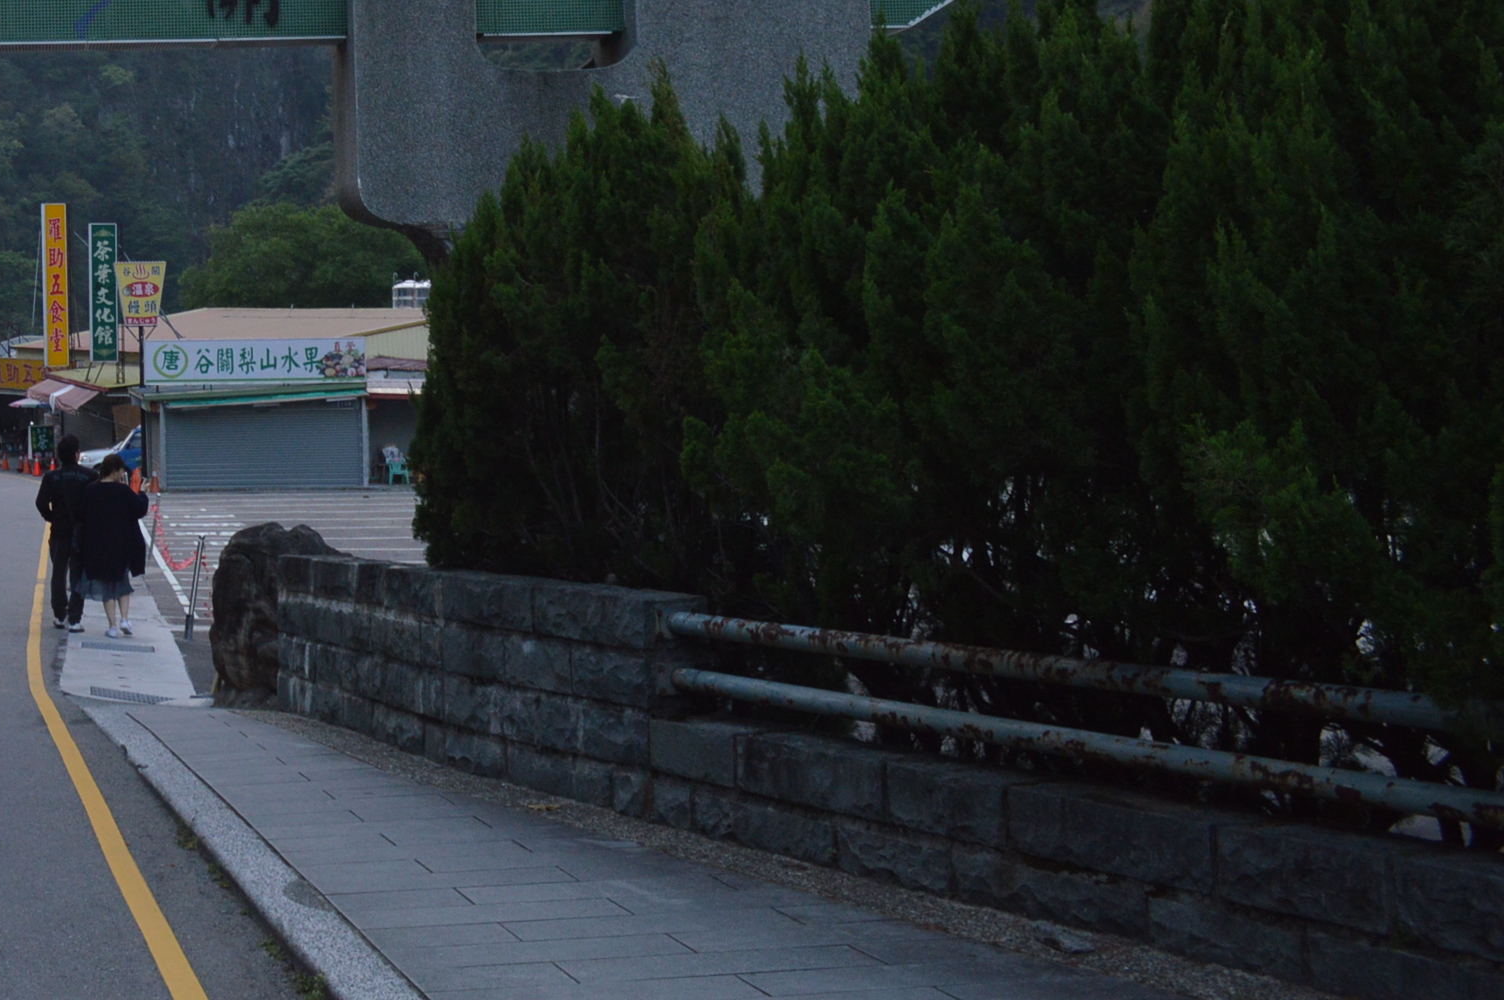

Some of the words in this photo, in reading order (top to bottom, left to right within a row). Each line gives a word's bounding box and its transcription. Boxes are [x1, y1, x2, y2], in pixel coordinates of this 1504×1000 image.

[93, 240, 115, 345] 茶葉文化館
[128, 300, 157, 314] 饅頭
[161, 350, 179, 371] 唐
[194, 347, 323, 374] 谷關梨山水果
